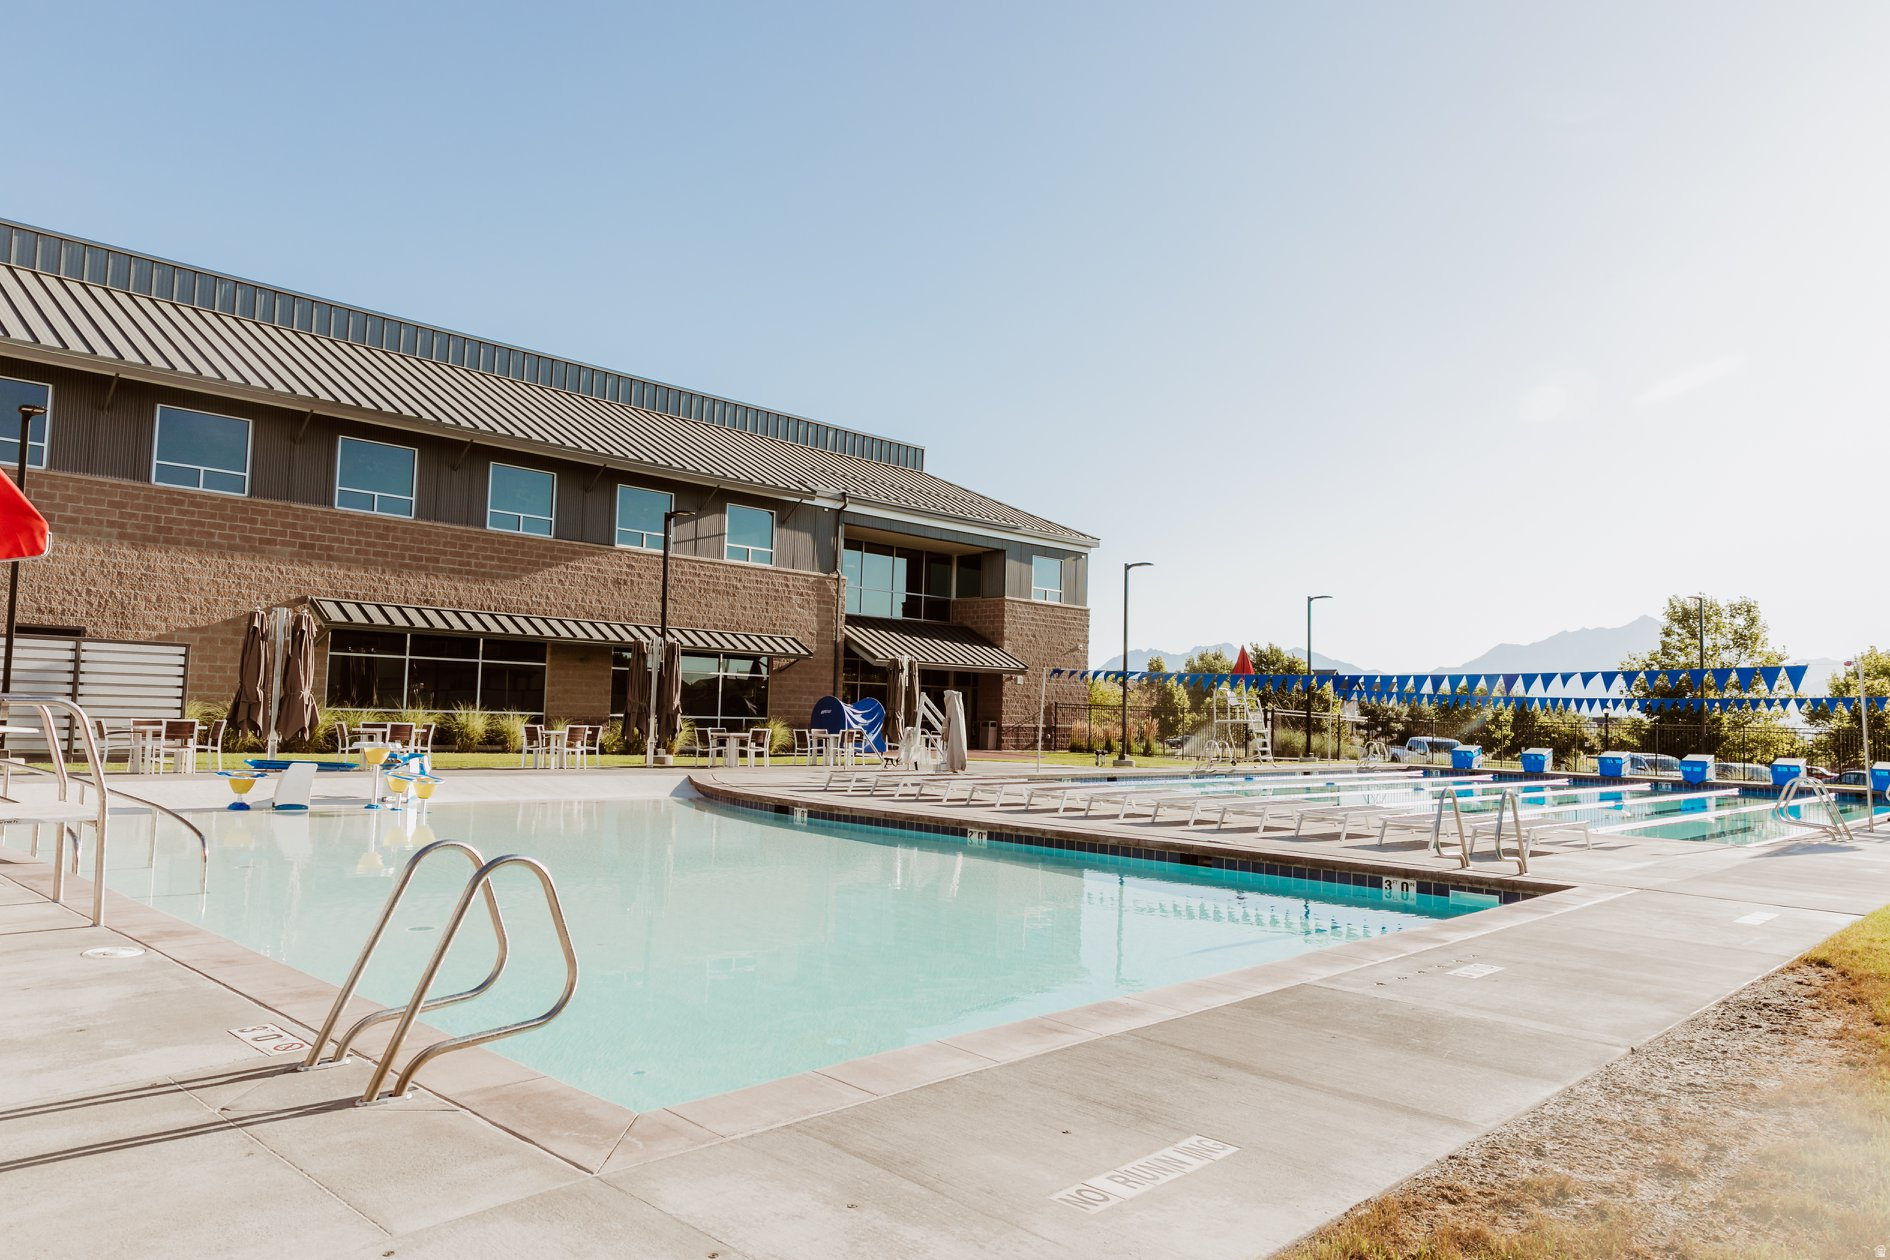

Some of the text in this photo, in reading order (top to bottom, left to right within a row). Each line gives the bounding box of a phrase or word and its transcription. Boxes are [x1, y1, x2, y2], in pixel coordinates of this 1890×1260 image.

[1384, 879, 1392, 891] 3
[1401, 881, 1409, 892] 0
[1057, 1138, 1229, 1211] NO RUNNING
